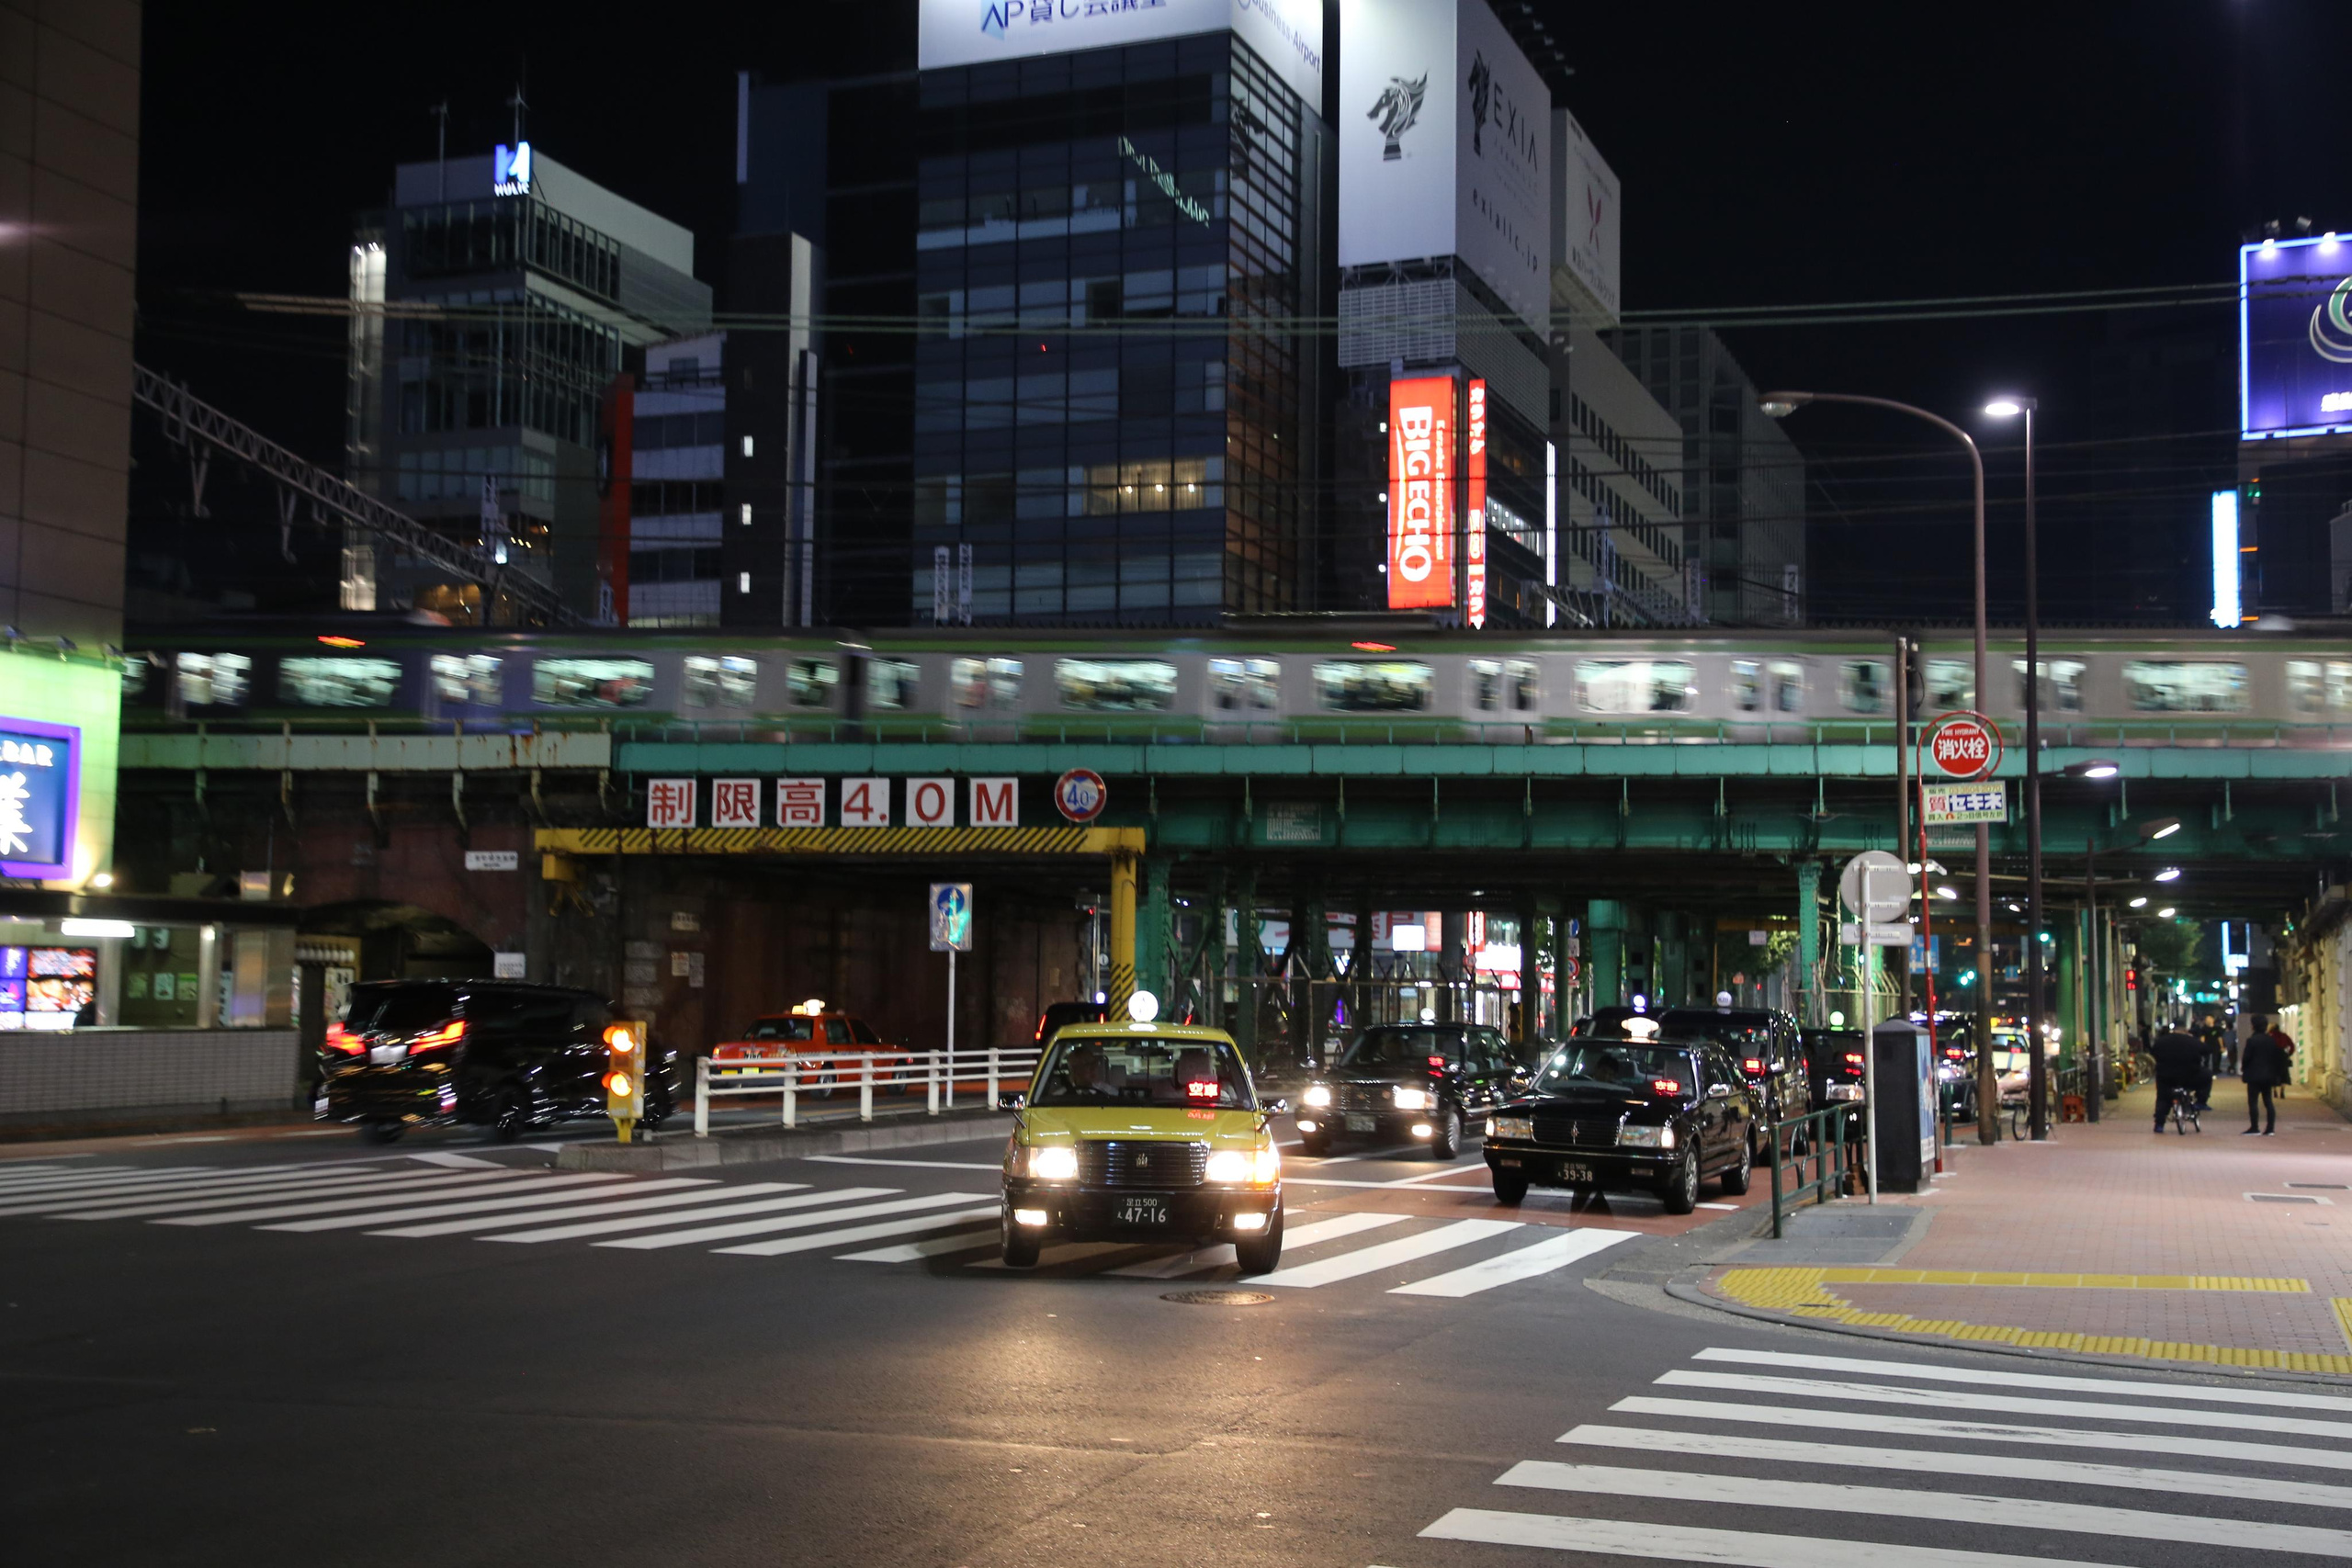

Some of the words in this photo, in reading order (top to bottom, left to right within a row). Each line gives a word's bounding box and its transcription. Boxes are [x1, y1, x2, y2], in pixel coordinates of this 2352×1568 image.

[1398, 406, 1432, 476] BIG
[1399, 480, 1432, 582] ECHO
[0, 739, 53, 767] BAR
[1938, 738, 1985, 761] 消火栓
[1188, 1081, 1218, 1098] 空車
[1563, 1168, 1593, 1182] 39-38
[1125, 1207, 1167, 1223] 47-16
